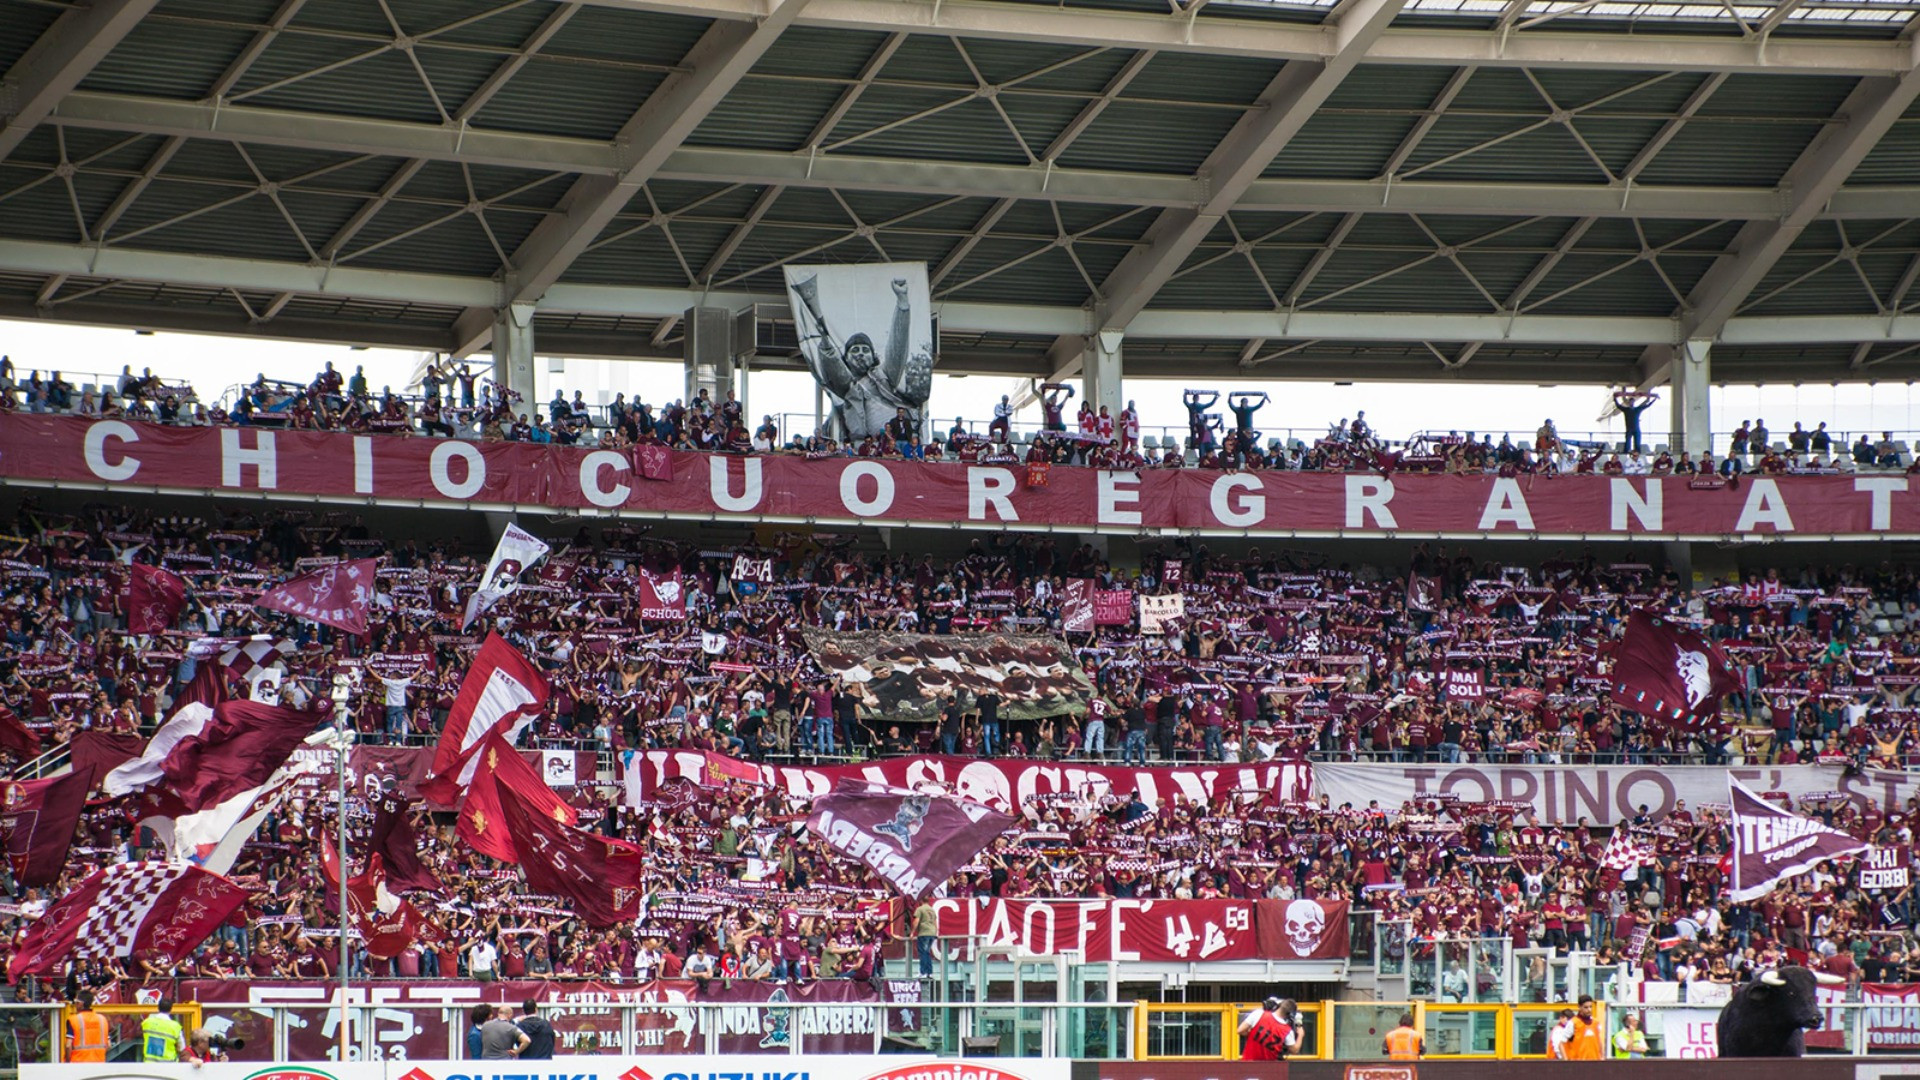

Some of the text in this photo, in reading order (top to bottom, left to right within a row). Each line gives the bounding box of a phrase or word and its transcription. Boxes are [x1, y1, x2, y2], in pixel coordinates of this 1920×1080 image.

[731, 555, 772, 580] AOSTA
[1165, 569, 1181, 581] 12
[641, 607, 685, 620] SCHOOL
[1452, 671, 1478, 684] MAI
[1450, 684, 1482, 697] SOLI
[1094, 704, 1105, 716] 12
[1403, 767, 1677, 829] TORINO
[1763, 835, 1818, 864] TORINO
[1869, 849, 1898, 869] MAI
[1860, 868, 1909, 889] GOBBI
[932, 898, 1055, 962] CIAO
[1225, 906, 1249, 931] 69
[888, 982, 920, 993] UNICA
[565, 991, 611, 1015] THE
[1253, 1025, 1283, 1053] 112
[1867, 1031, 1920, 1045] TORINO
